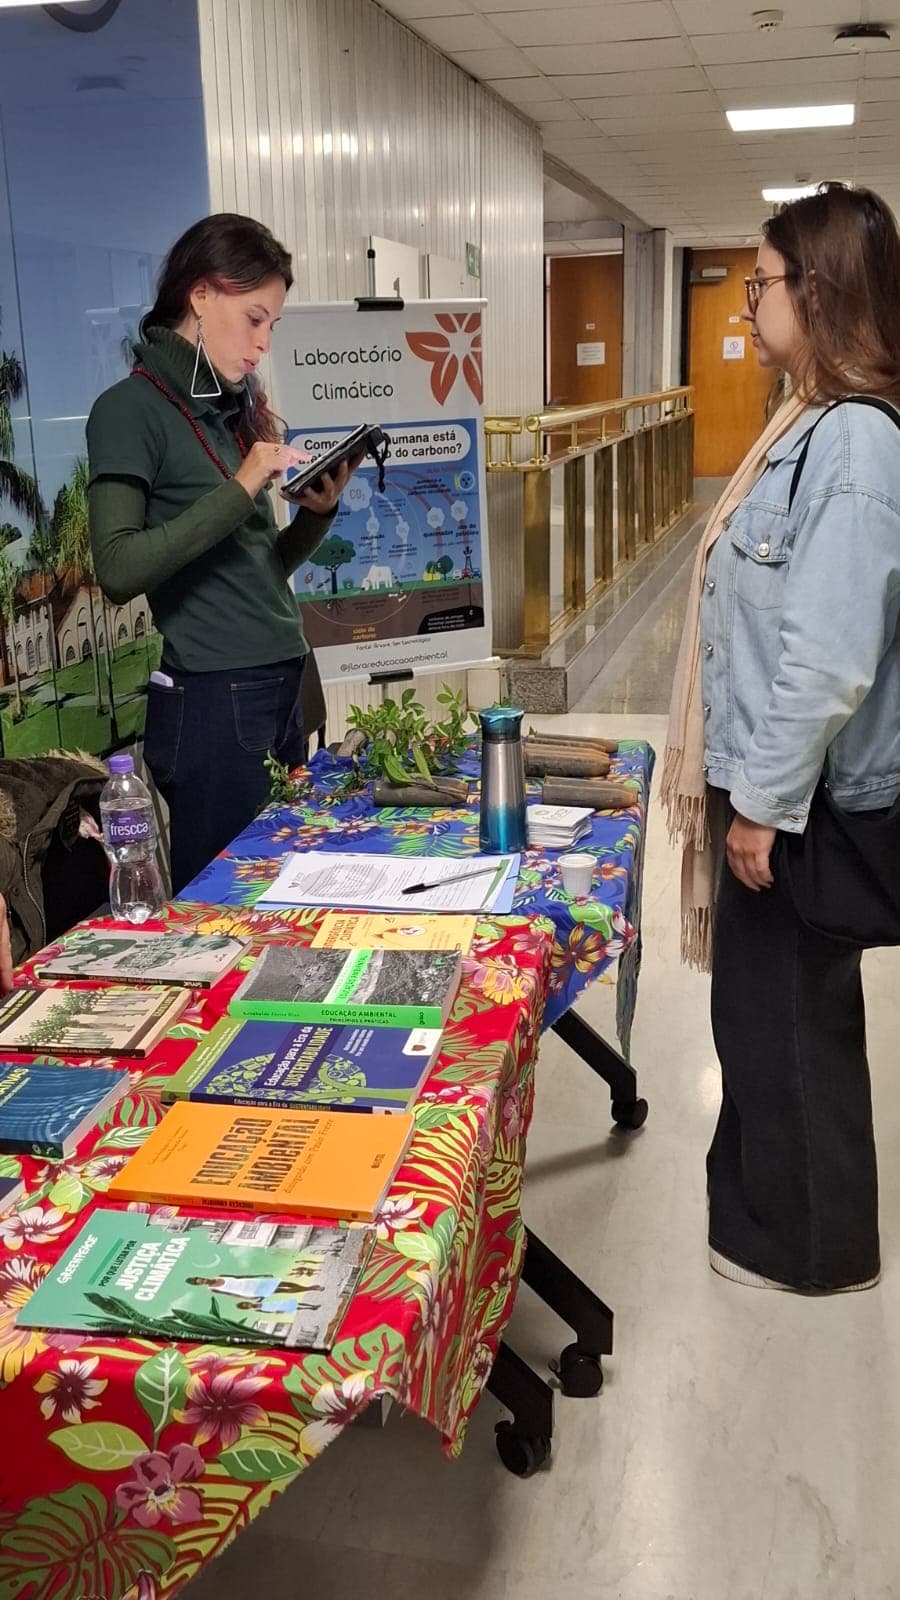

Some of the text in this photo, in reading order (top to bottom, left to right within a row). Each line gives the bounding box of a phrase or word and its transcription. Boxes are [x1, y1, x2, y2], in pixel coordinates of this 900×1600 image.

[294, 345, 402, 366] Laboratório
[312, 381, 394, 400] Climático
[395, 447, 409, 458] do
[412, 443, 462, 457] carbono?
[433, 429, 456, 441] está
[110, 822, 149, 836] frescca
[321, 1009, 357, 1017] EDUCAÇÃO
[263, 1061, 291, 1086] Educação
[284, 1048, 300, 1060] para
[293, 1034, 308, 1043] Era
[301, 1026, 313, 1034] da
[281, 1027, 333, 1086] SUSTENTABILIDADE
[56, 1234, 98, 1284] GREENPEACE
[98, 1240, 138, 1287] POR QUE LUTAR POR
[115, 1241, 163, 1291] JUSTIÇA
[134, 1237, 191, 1301] CLIMÁTICA
